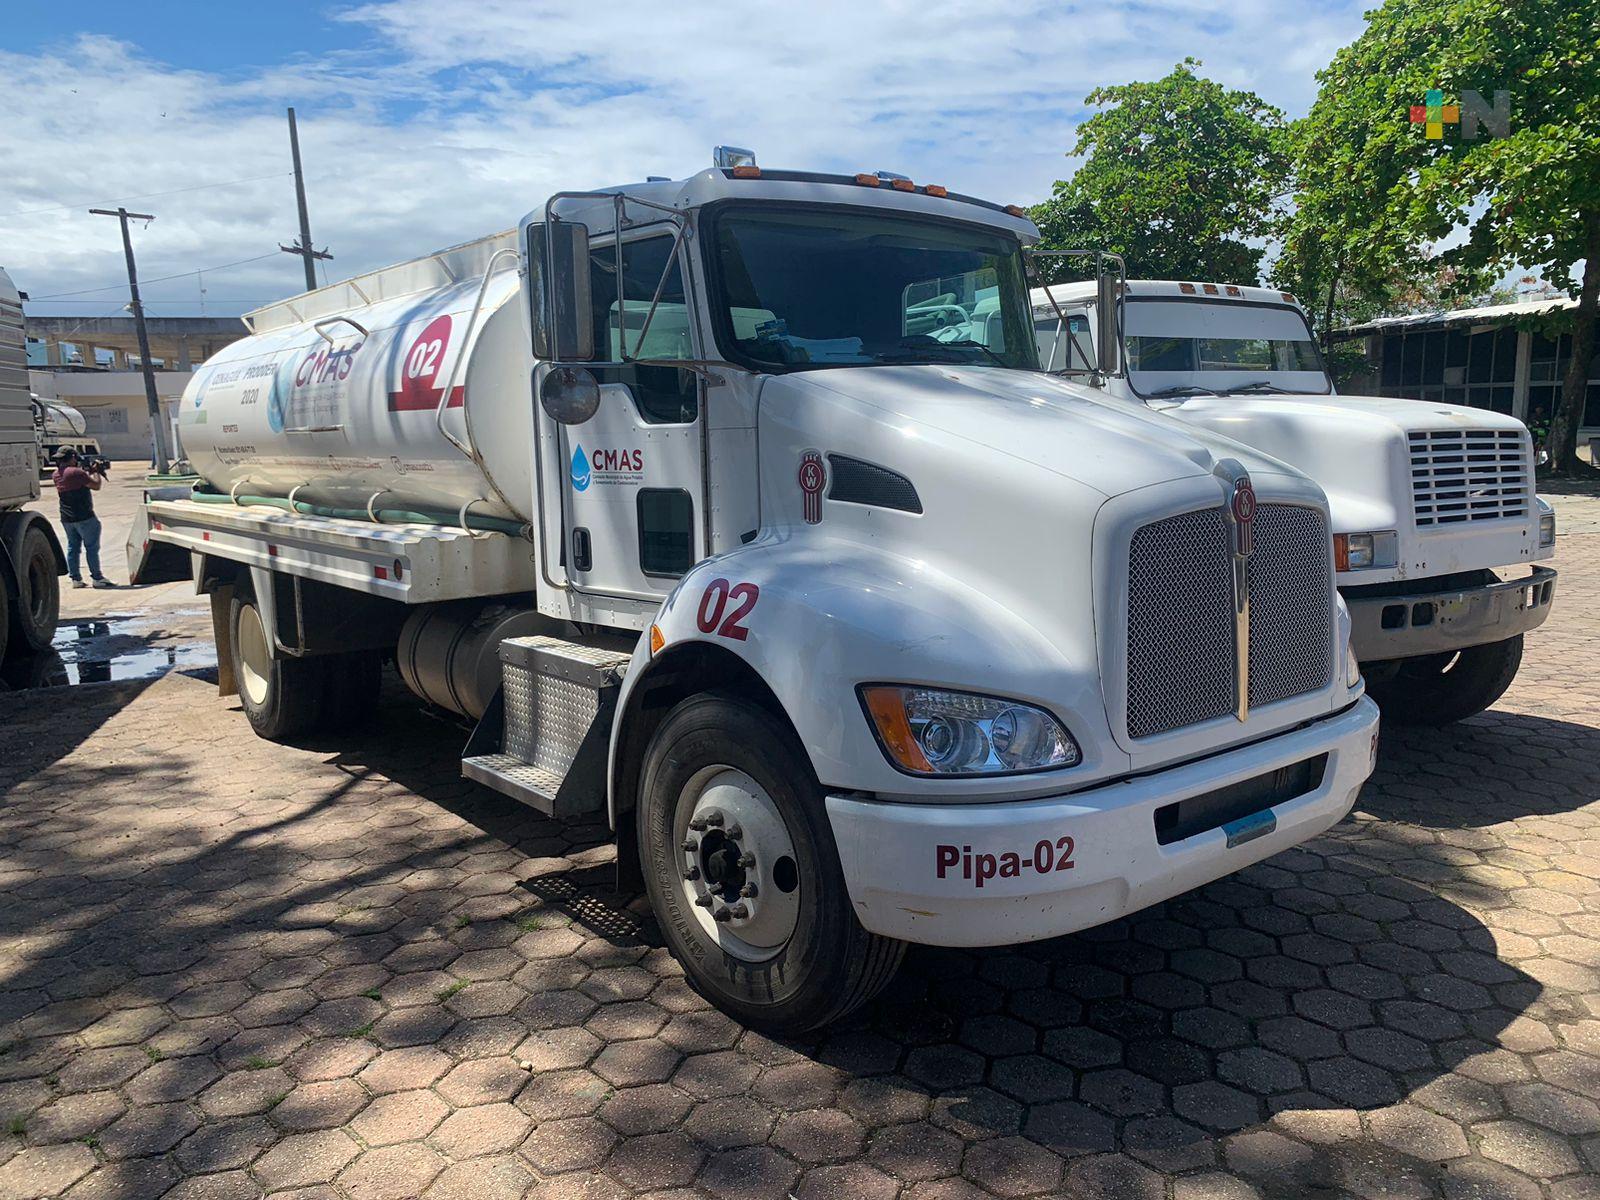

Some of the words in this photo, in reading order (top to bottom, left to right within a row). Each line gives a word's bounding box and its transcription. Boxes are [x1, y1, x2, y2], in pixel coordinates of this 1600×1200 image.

[296, 343, 362, 387] CMAS
[408, 338, 442, 379] 02
[241, 388, 259, 405] 2020
[592, 449, 643, 471] CMAS
[697, 577, 759, 641] 02
[936, 836, 1075, 888] Pipa-02
